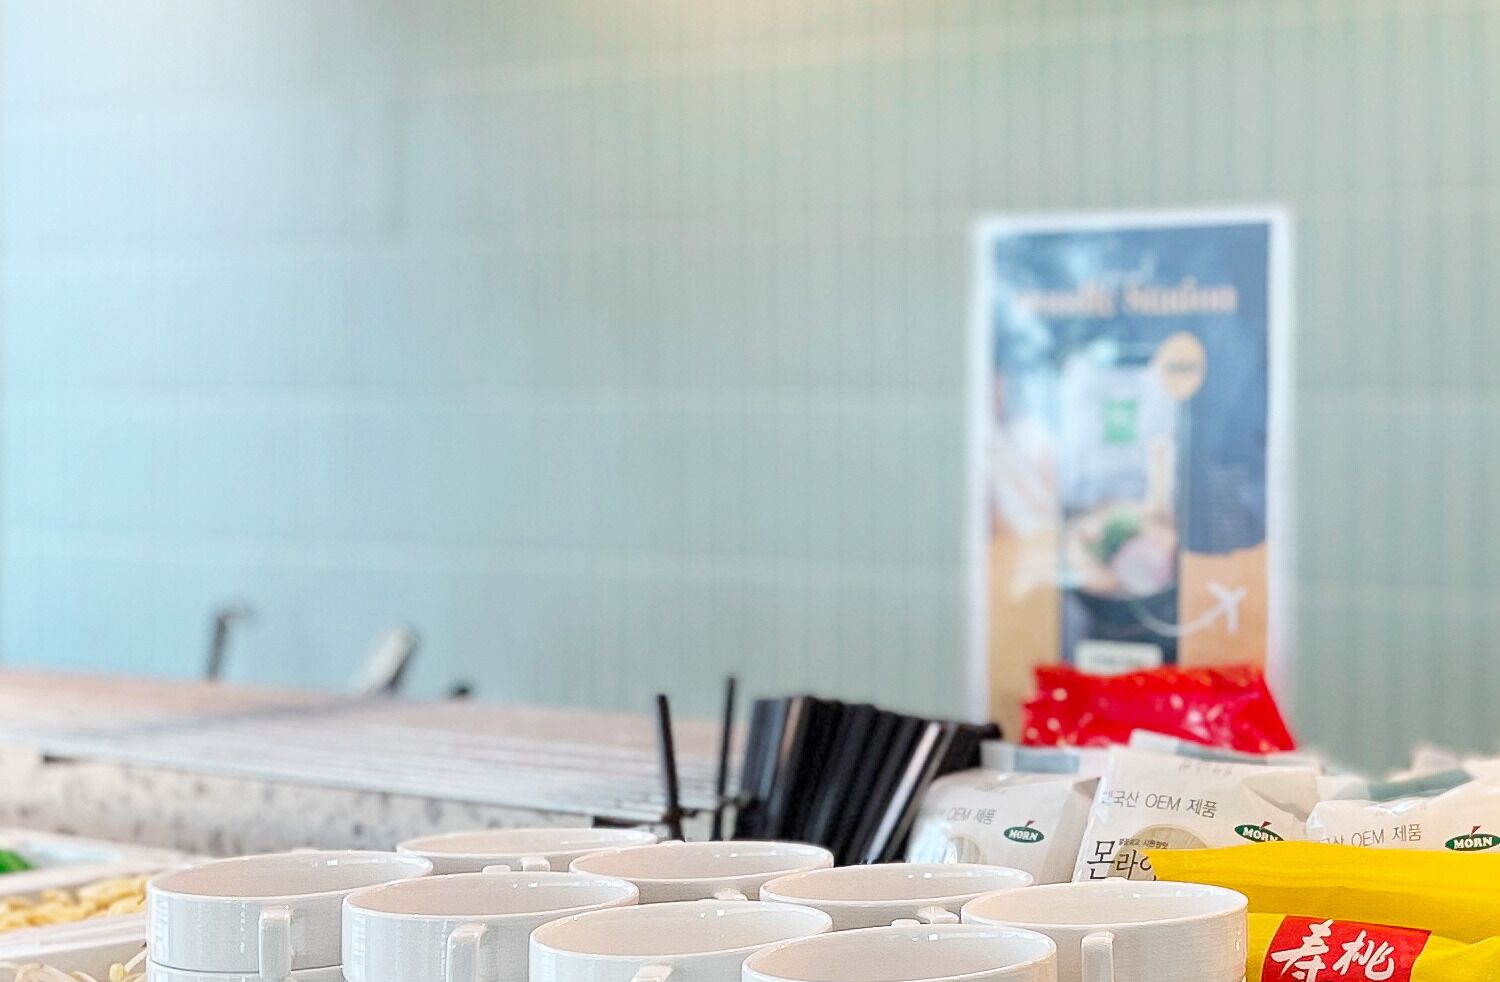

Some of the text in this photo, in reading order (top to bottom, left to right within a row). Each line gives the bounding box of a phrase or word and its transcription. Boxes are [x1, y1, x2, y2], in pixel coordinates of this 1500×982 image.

[1144, 793, 1180, 813] OEM
[1185, 798, 1218, 819] 제품
[1351, 828, 1386, 848] OEM
[1392, 823, 1423, 843] 제품
[1453, 835, 1494, 850] MORN
